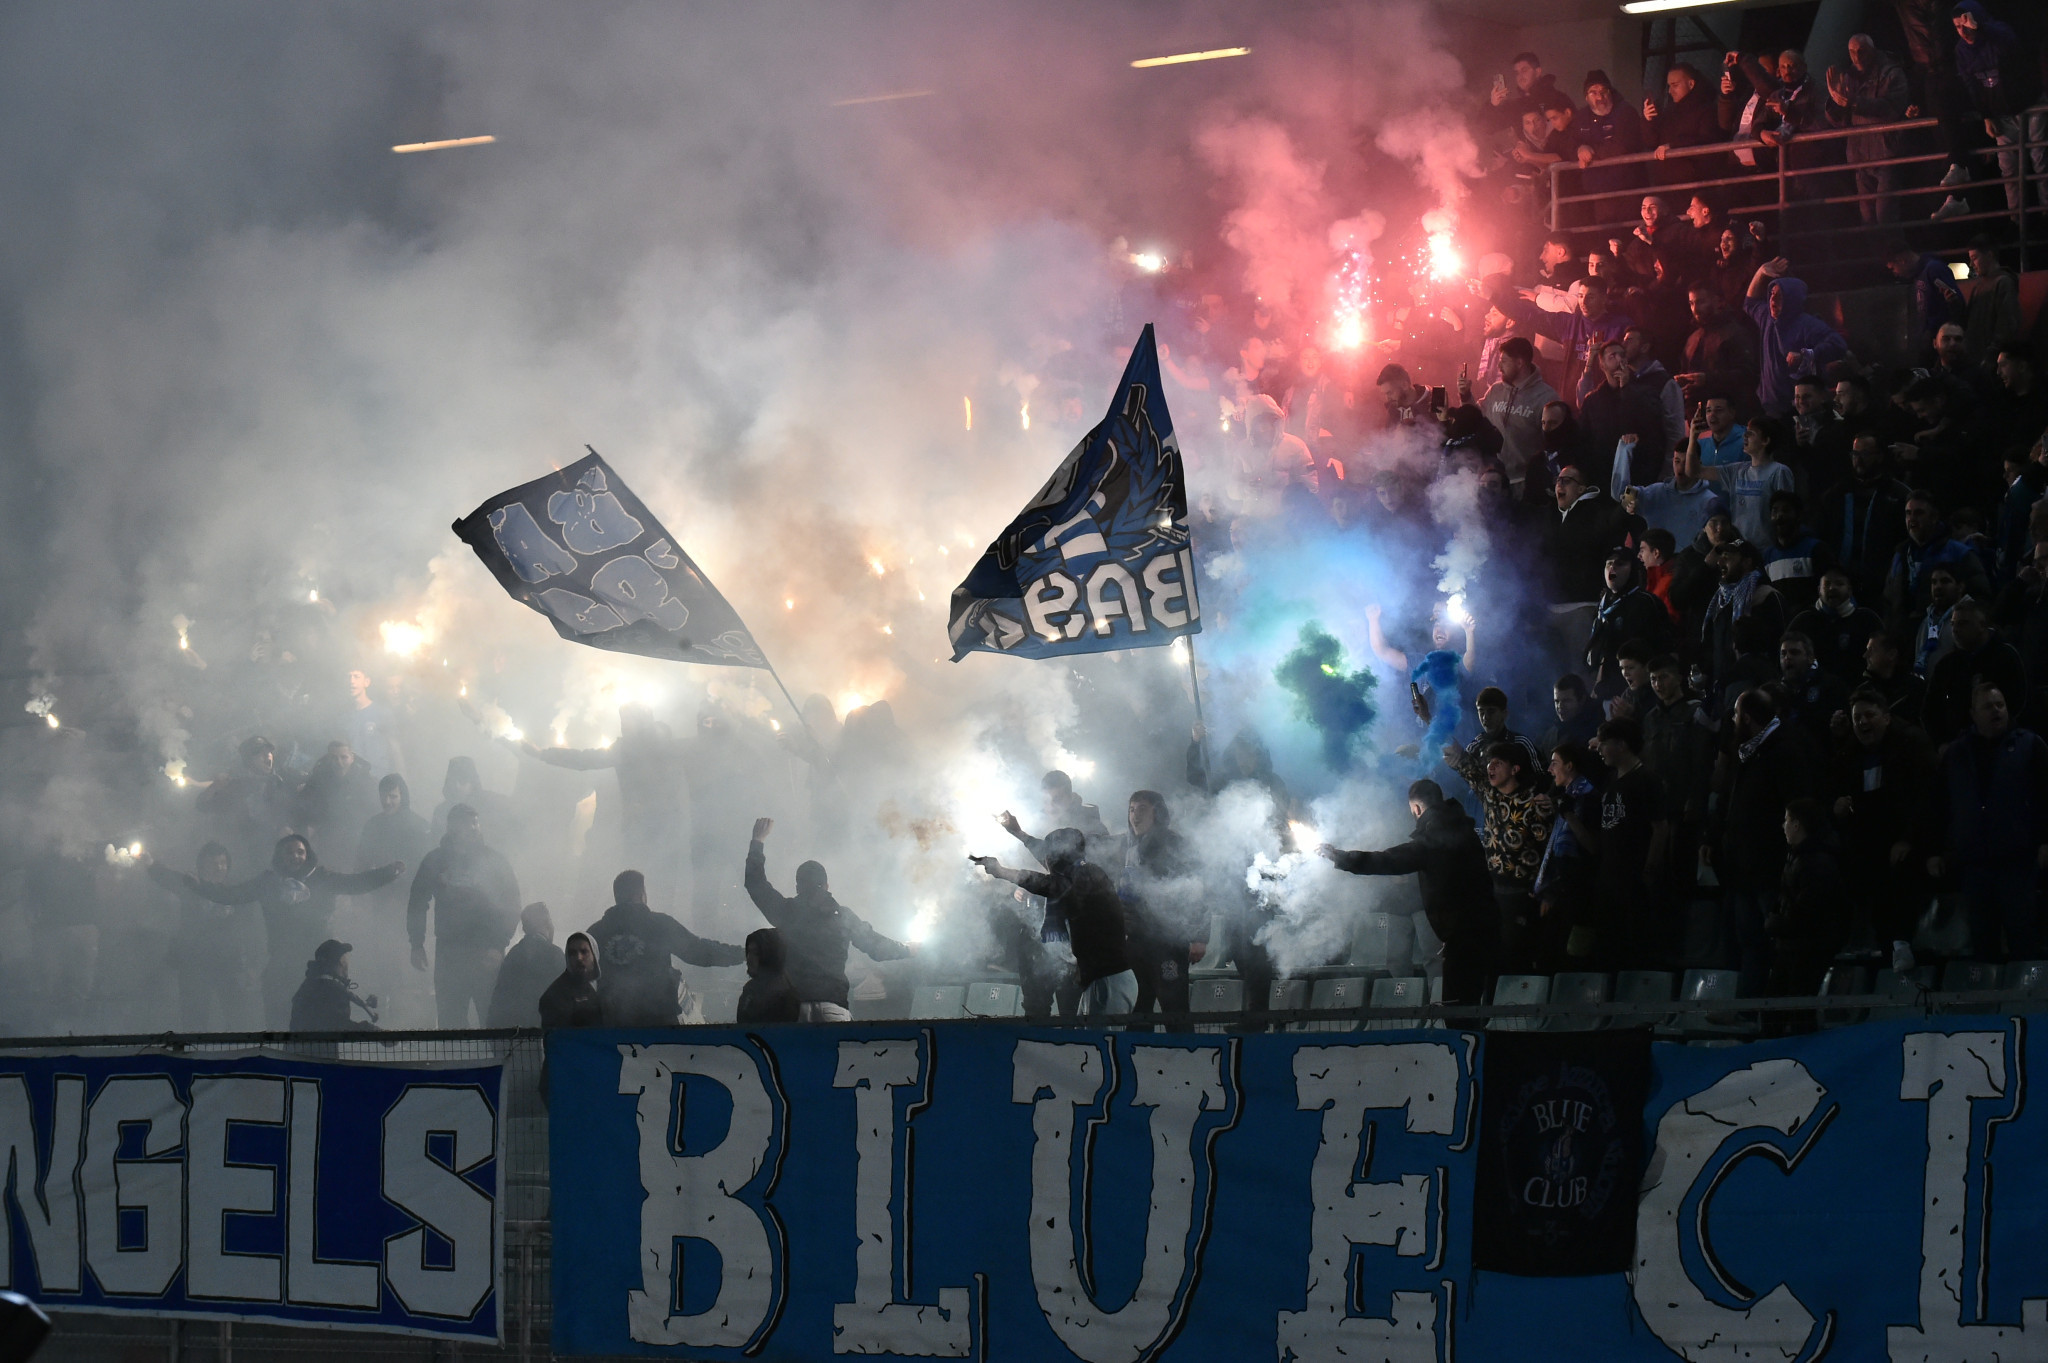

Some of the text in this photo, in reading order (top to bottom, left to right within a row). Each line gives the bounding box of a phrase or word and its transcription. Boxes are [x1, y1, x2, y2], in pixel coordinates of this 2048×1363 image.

[1531, 1099, 1593, 1134] BLUE
[616, 1030, 1480, 1363] BLUE
[1523, 1176, 1589, 1208] CLUB
